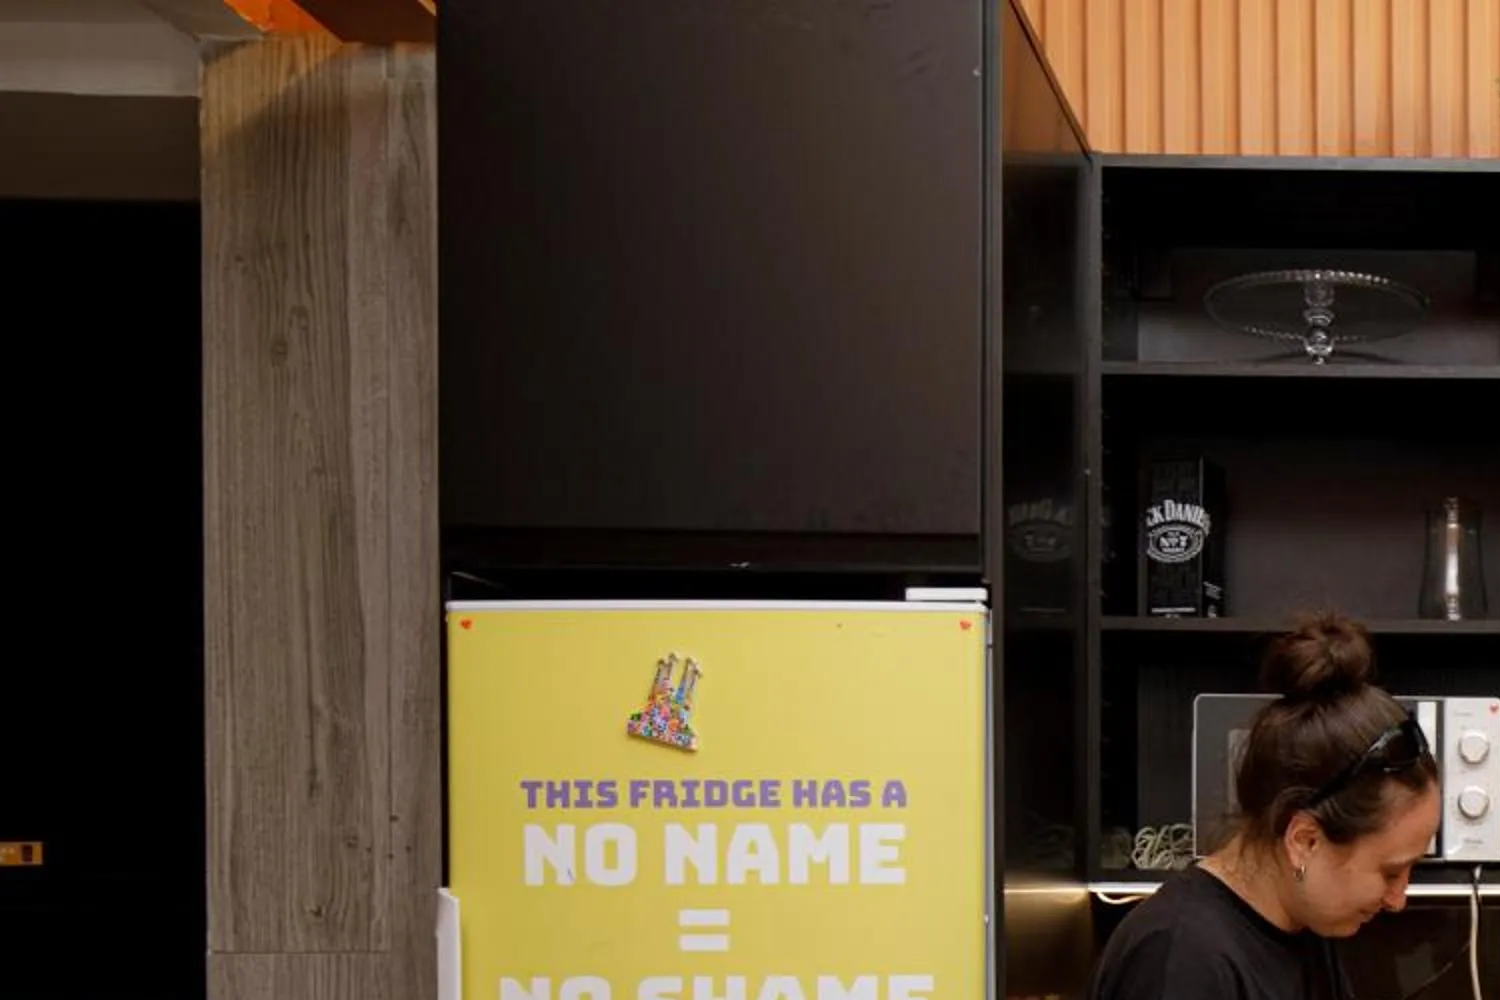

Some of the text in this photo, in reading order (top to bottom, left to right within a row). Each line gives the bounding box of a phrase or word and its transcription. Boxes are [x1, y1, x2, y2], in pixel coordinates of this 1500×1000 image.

[520, 779, 908, 808] THIS FRIDGE HAS A
[523, 823, 907, 886] NO NAME
[679, 909, 730, 952] =
